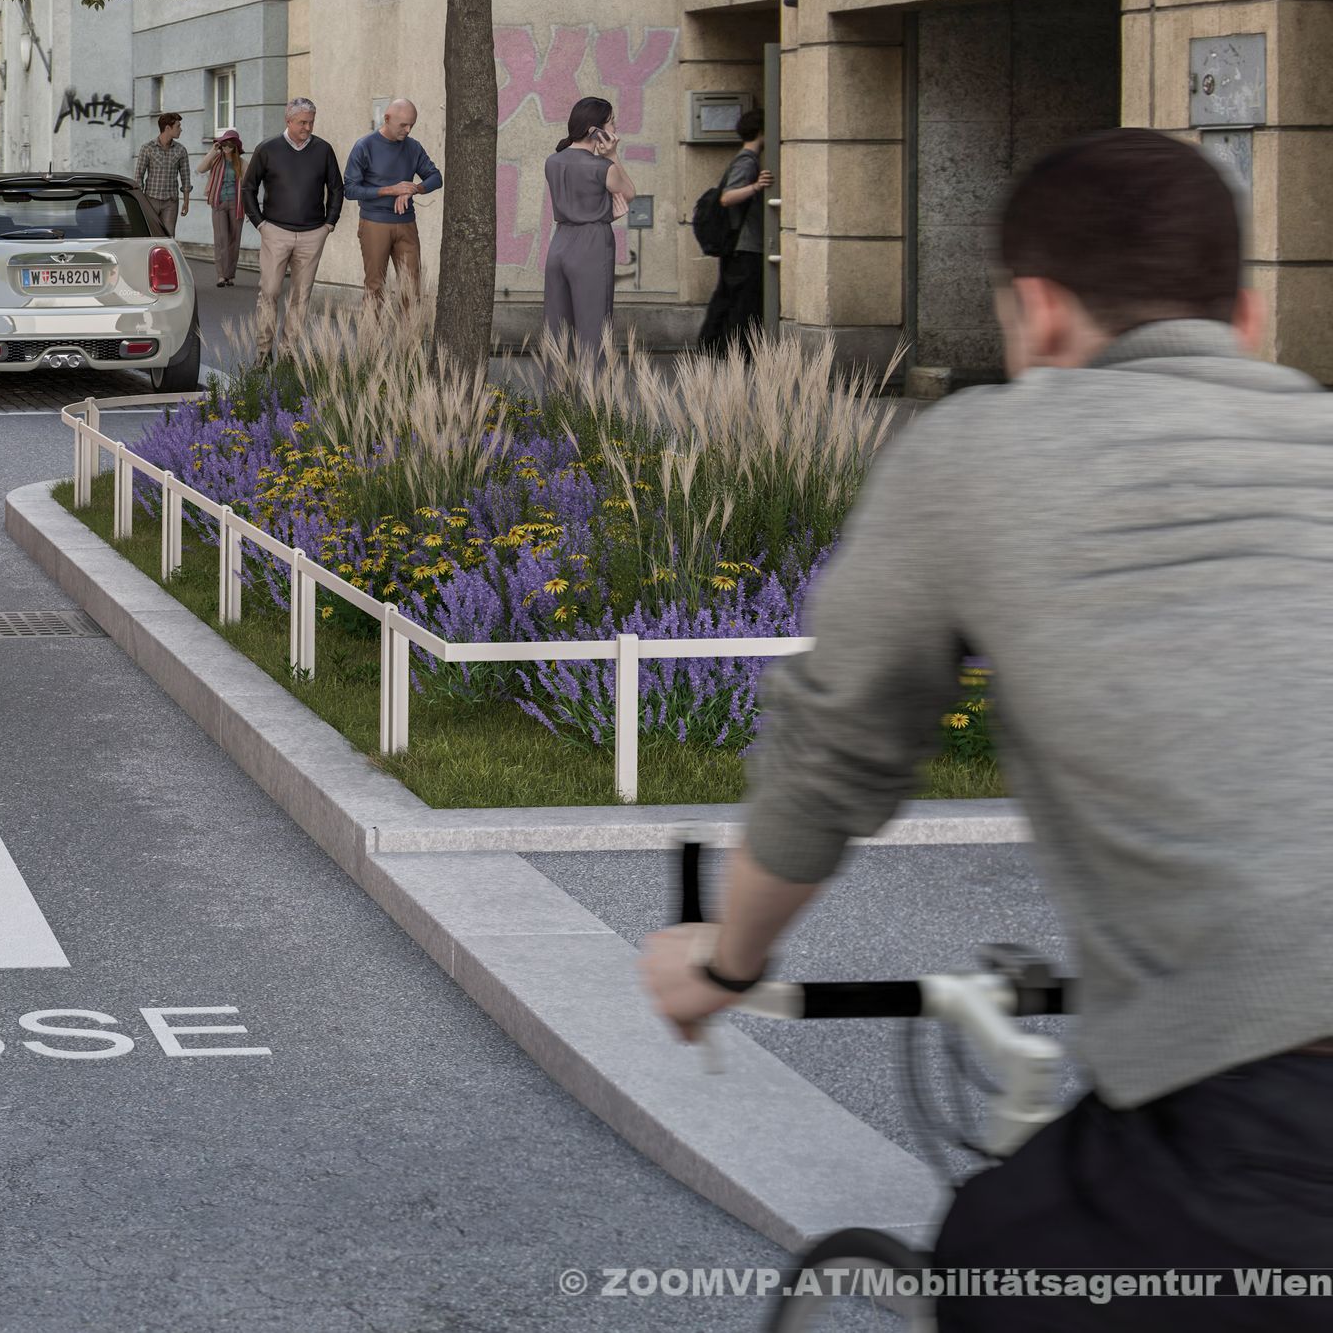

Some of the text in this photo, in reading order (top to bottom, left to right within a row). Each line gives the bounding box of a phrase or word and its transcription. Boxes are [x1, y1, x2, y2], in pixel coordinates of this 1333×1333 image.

[54, 88, 133, 138] ANTIFA
[31, 270, 101, 285] W 54820 M
